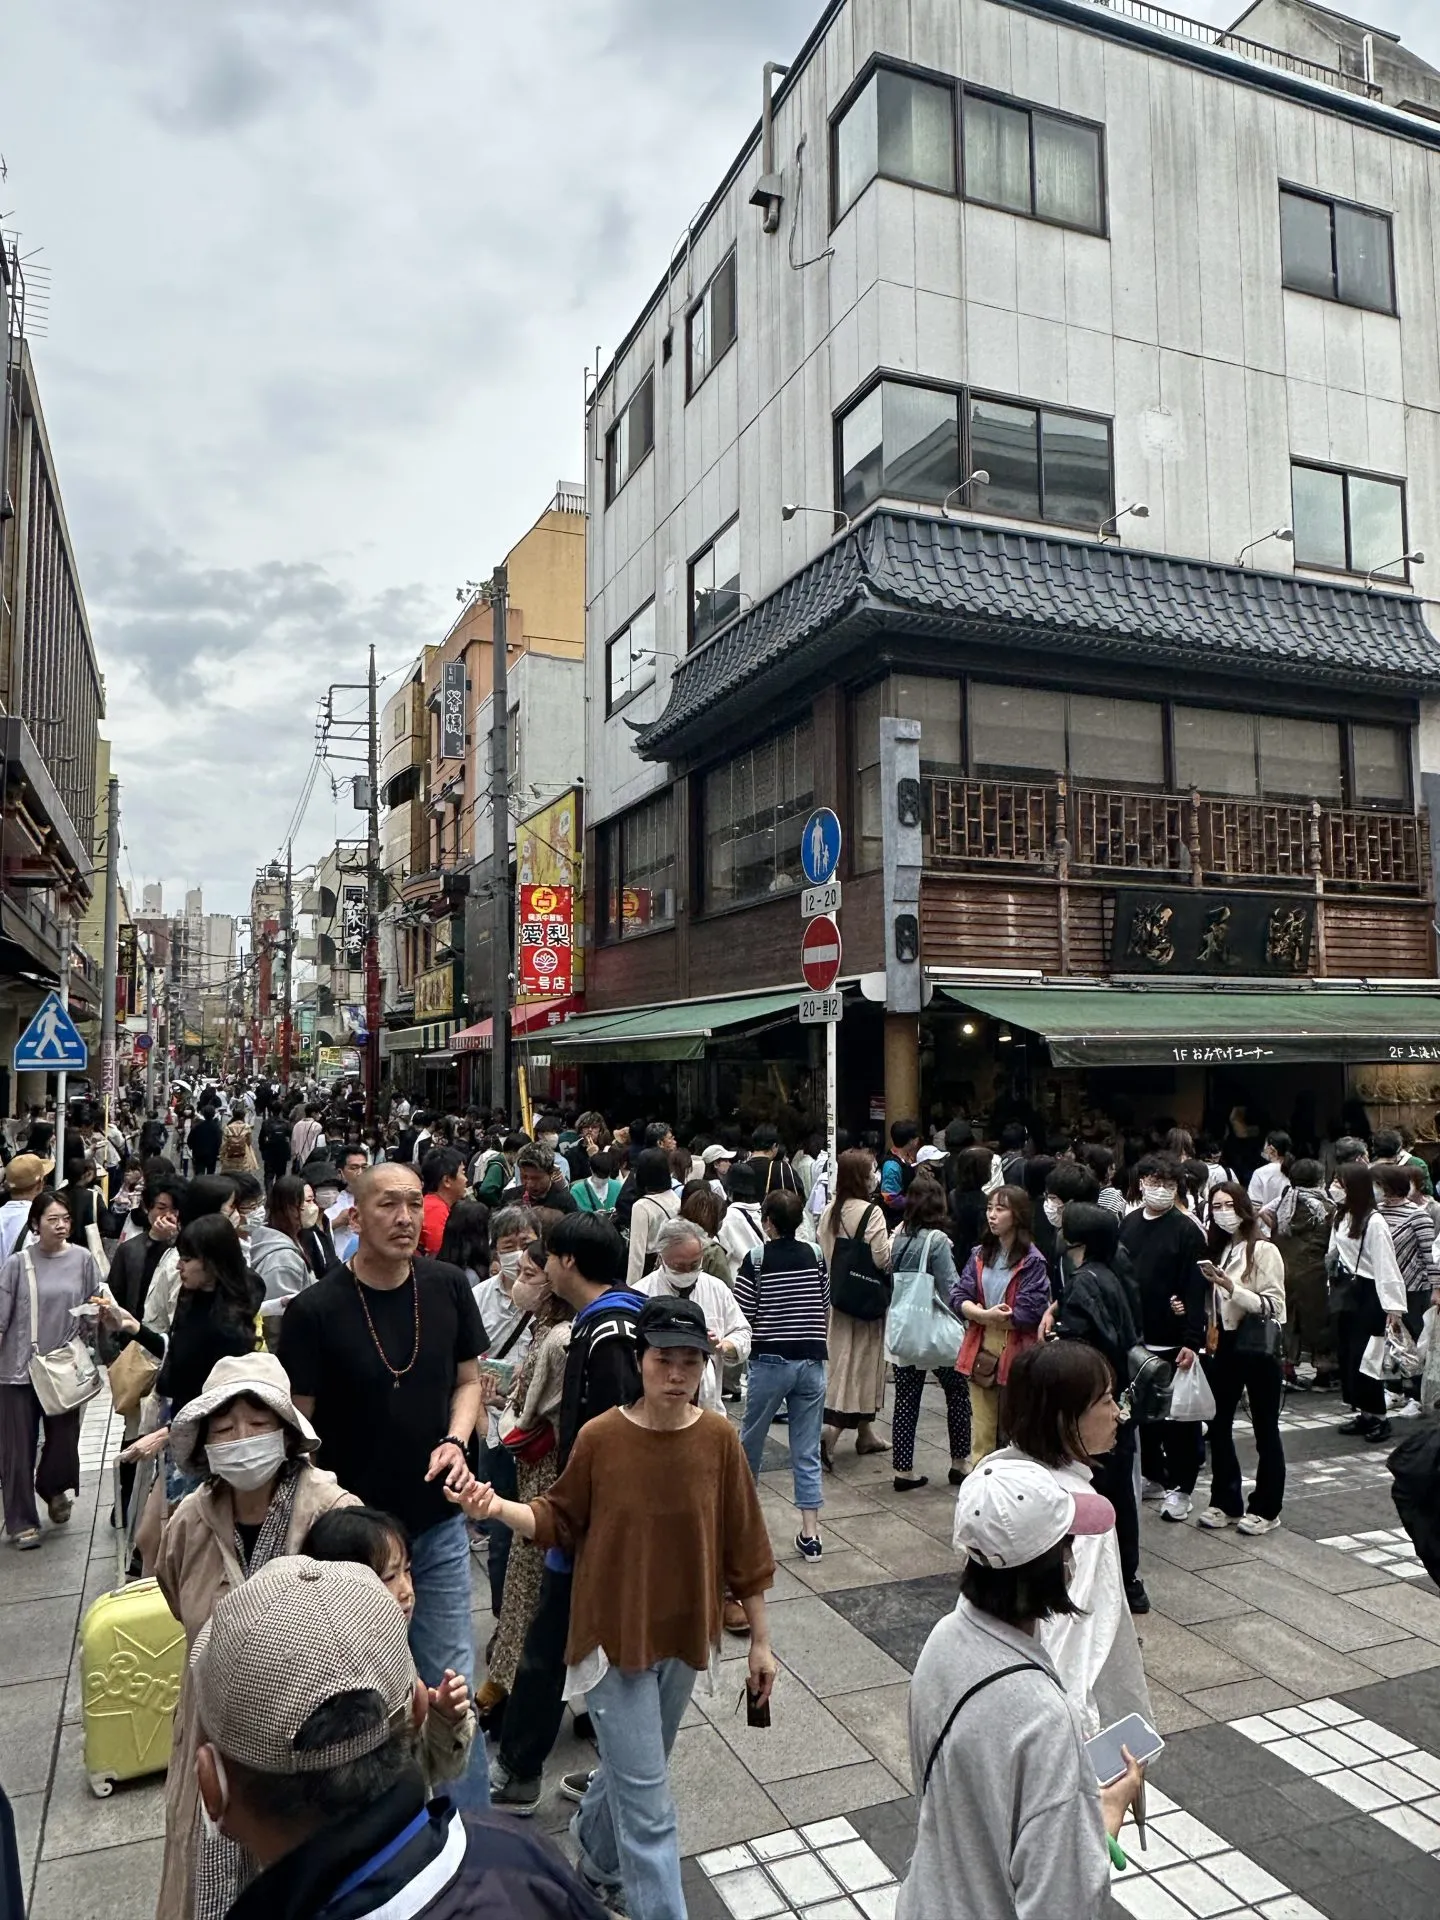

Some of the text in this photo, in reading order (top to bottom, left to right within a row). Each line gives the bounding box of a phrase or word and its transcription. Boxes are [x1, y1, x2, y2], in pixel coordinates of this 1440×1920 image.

[805, 889, 837, 912] 12-20
[522, 923, 570, 947] 愛梨
[523, 976, 566, 990] 二号店
[302, 1036, 310, 1049] P
[1172, 1046, 1274, 1061] 1F おみやげコーナー
[1389, 1046, 1404, 1058] 2F
